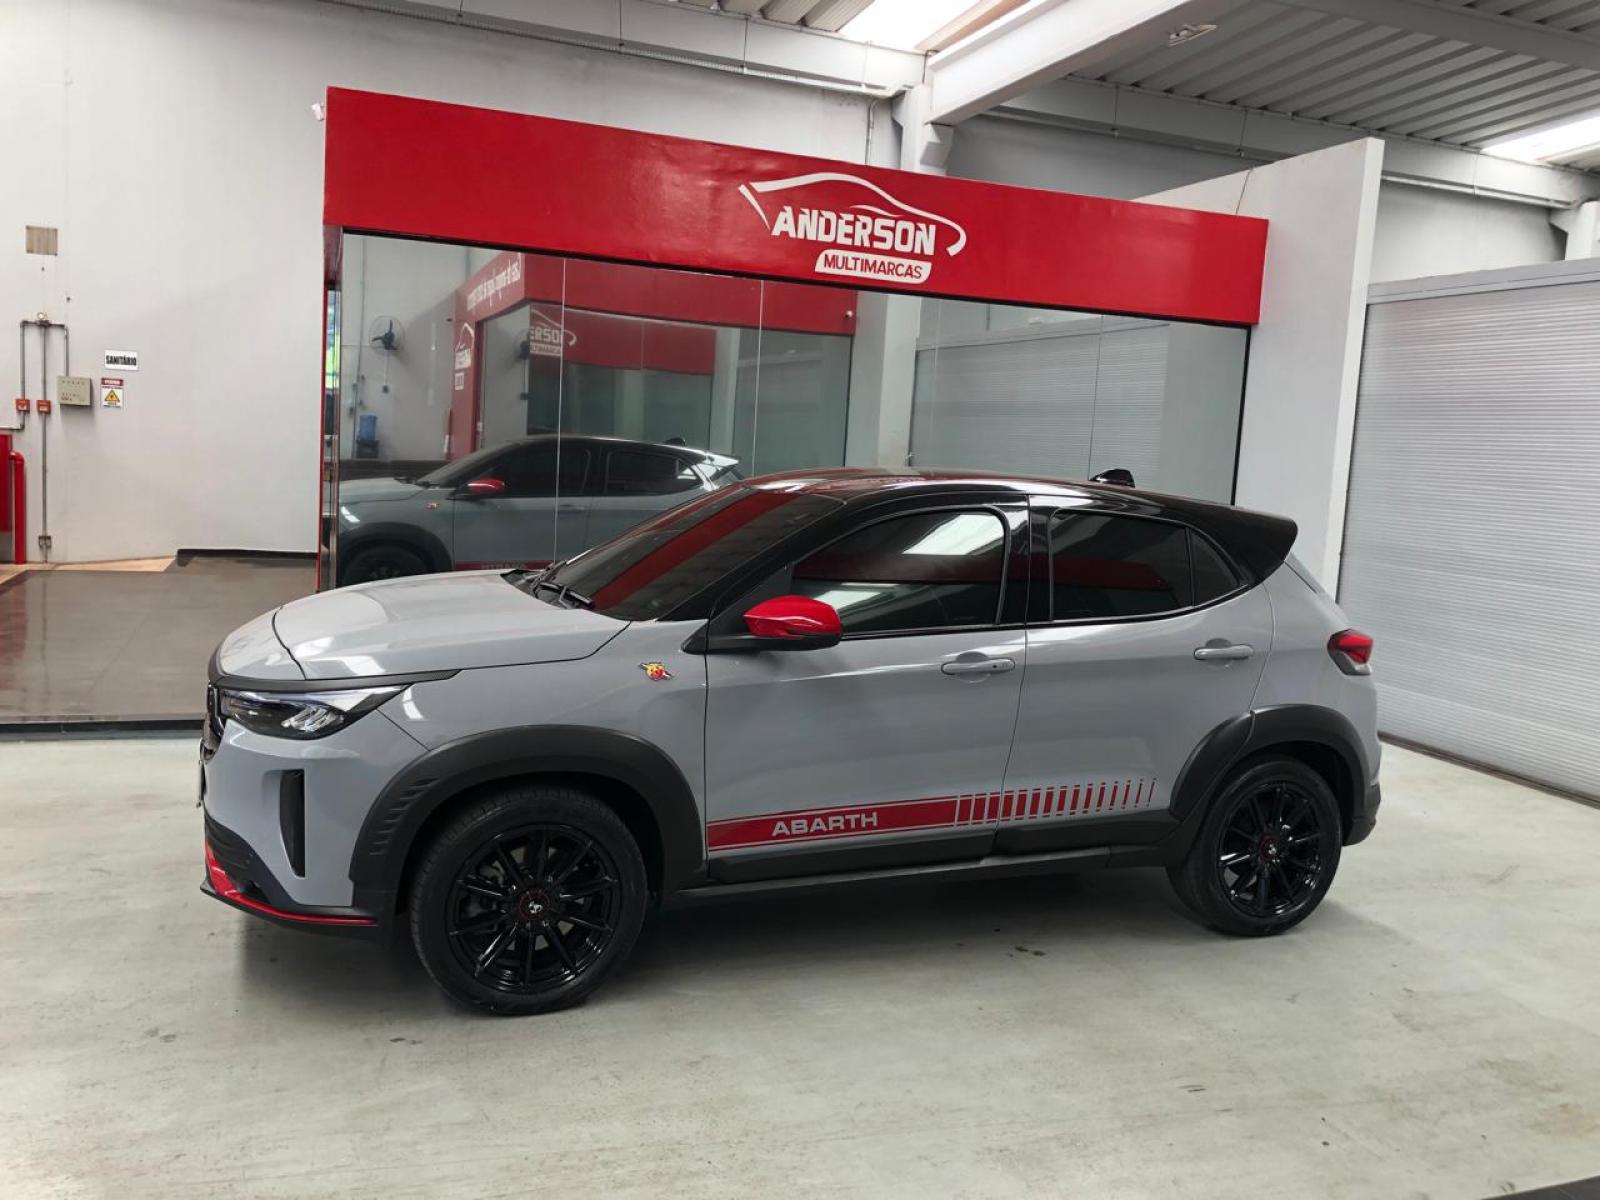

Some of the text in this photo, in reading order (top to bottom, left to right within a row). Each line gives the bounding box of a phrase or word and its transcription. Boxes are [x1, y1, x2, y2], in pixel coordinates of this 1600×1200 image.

[771, 205, 936, 256] ANDERSON
[823, 253, 923, 280] MULTIMARCAS
[772, 811, 878, 837] ABARTH
